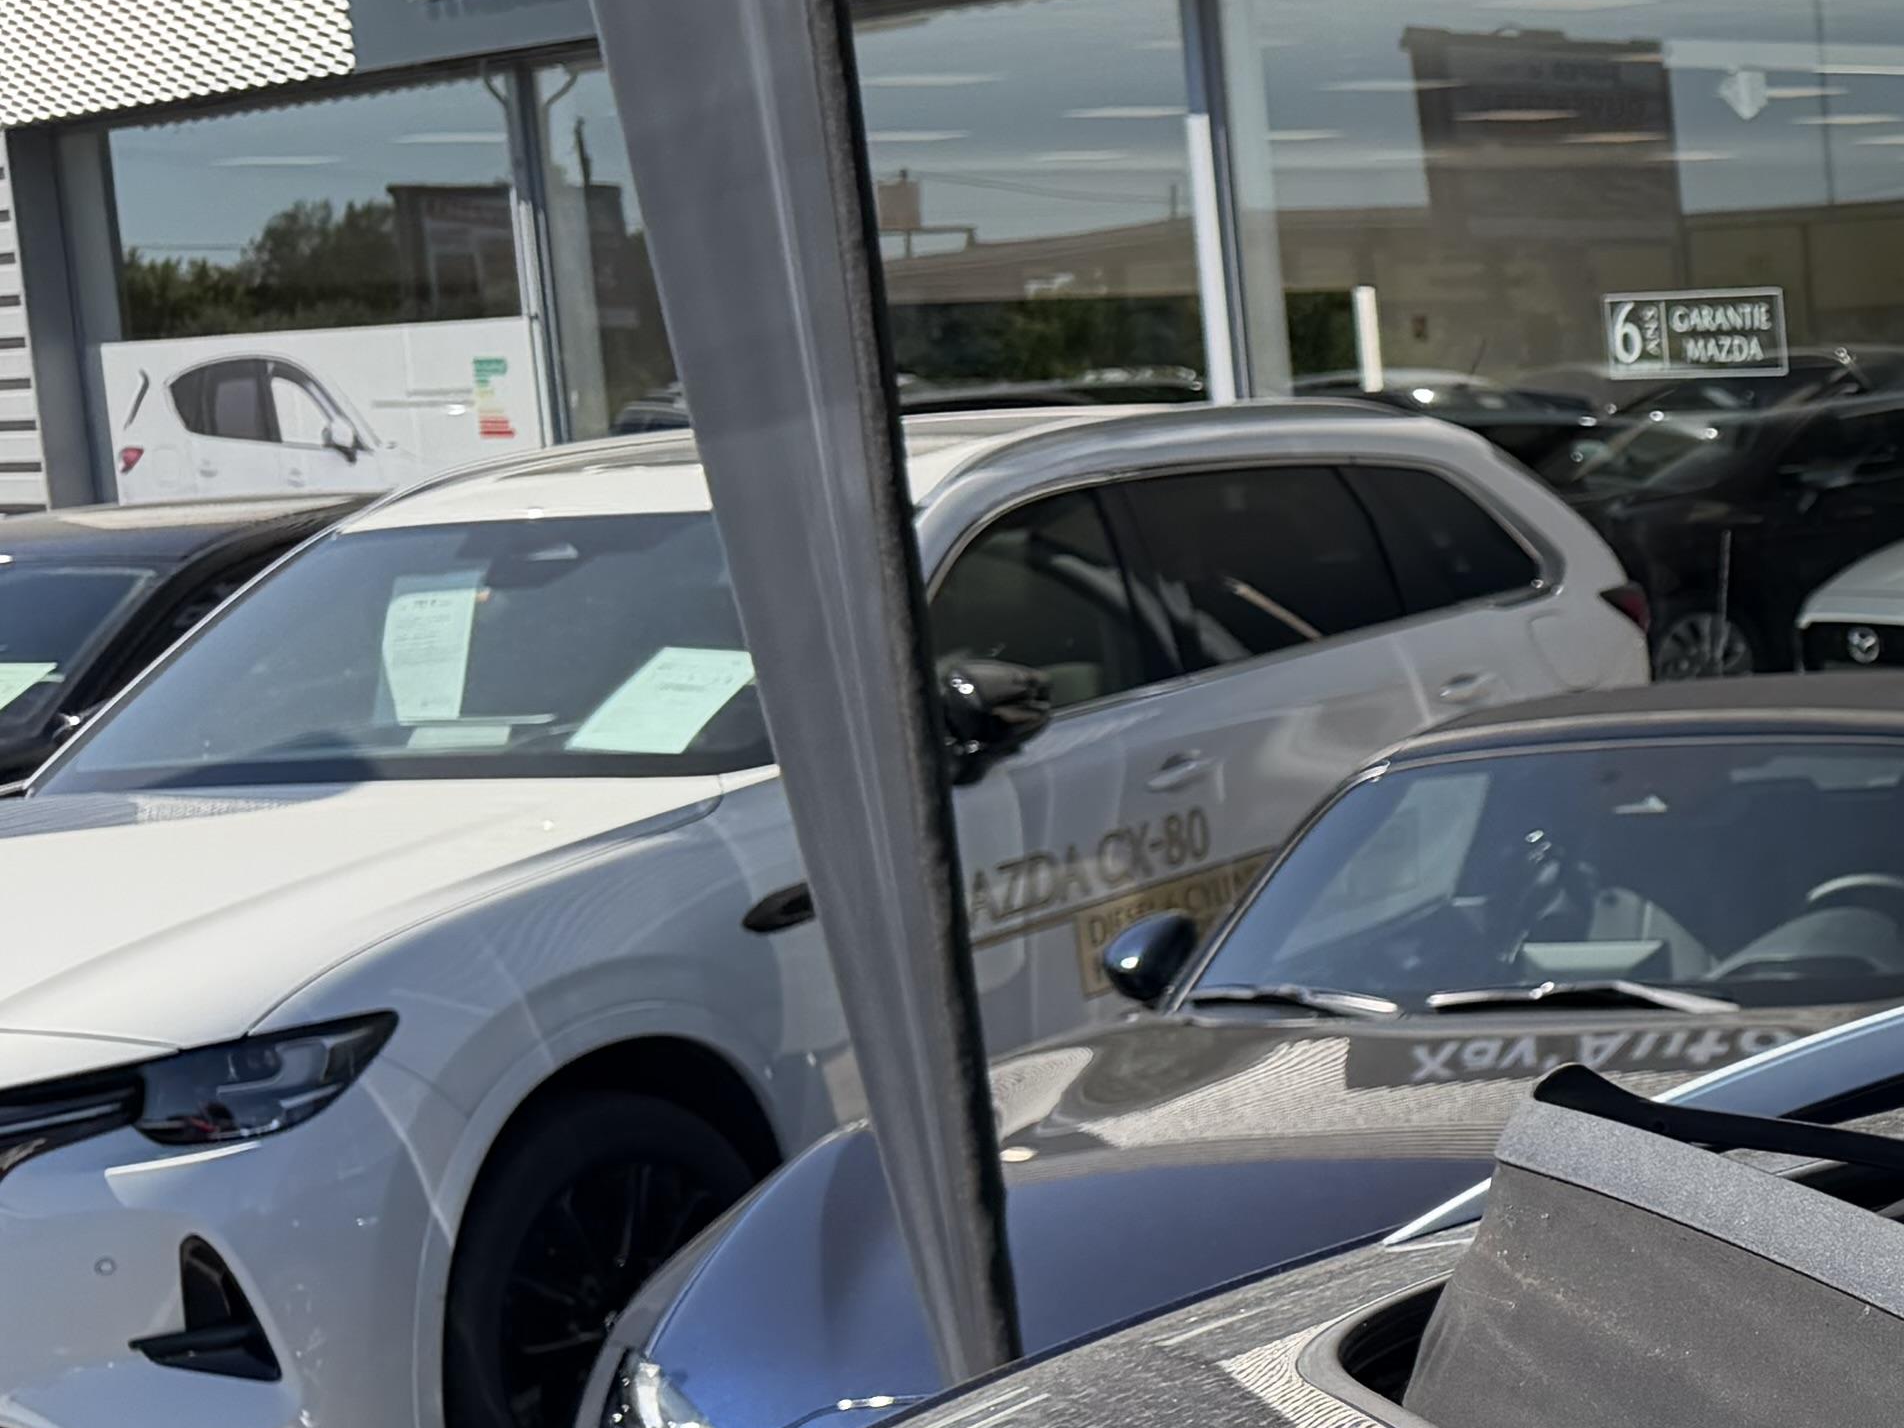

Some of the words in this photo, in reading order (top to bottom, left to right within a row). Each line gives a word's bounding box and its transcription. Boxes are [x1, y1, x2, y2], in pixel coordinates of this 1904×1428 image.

[1613, 301, 1643, 365] 6
[1669, 302, 1772, 333] GARANTIE
[1683, 334, 1765, 364] MAZDA
[966, 842, 1093, 924] AZDA
[1097, 806, 1211, 888] CX-80
